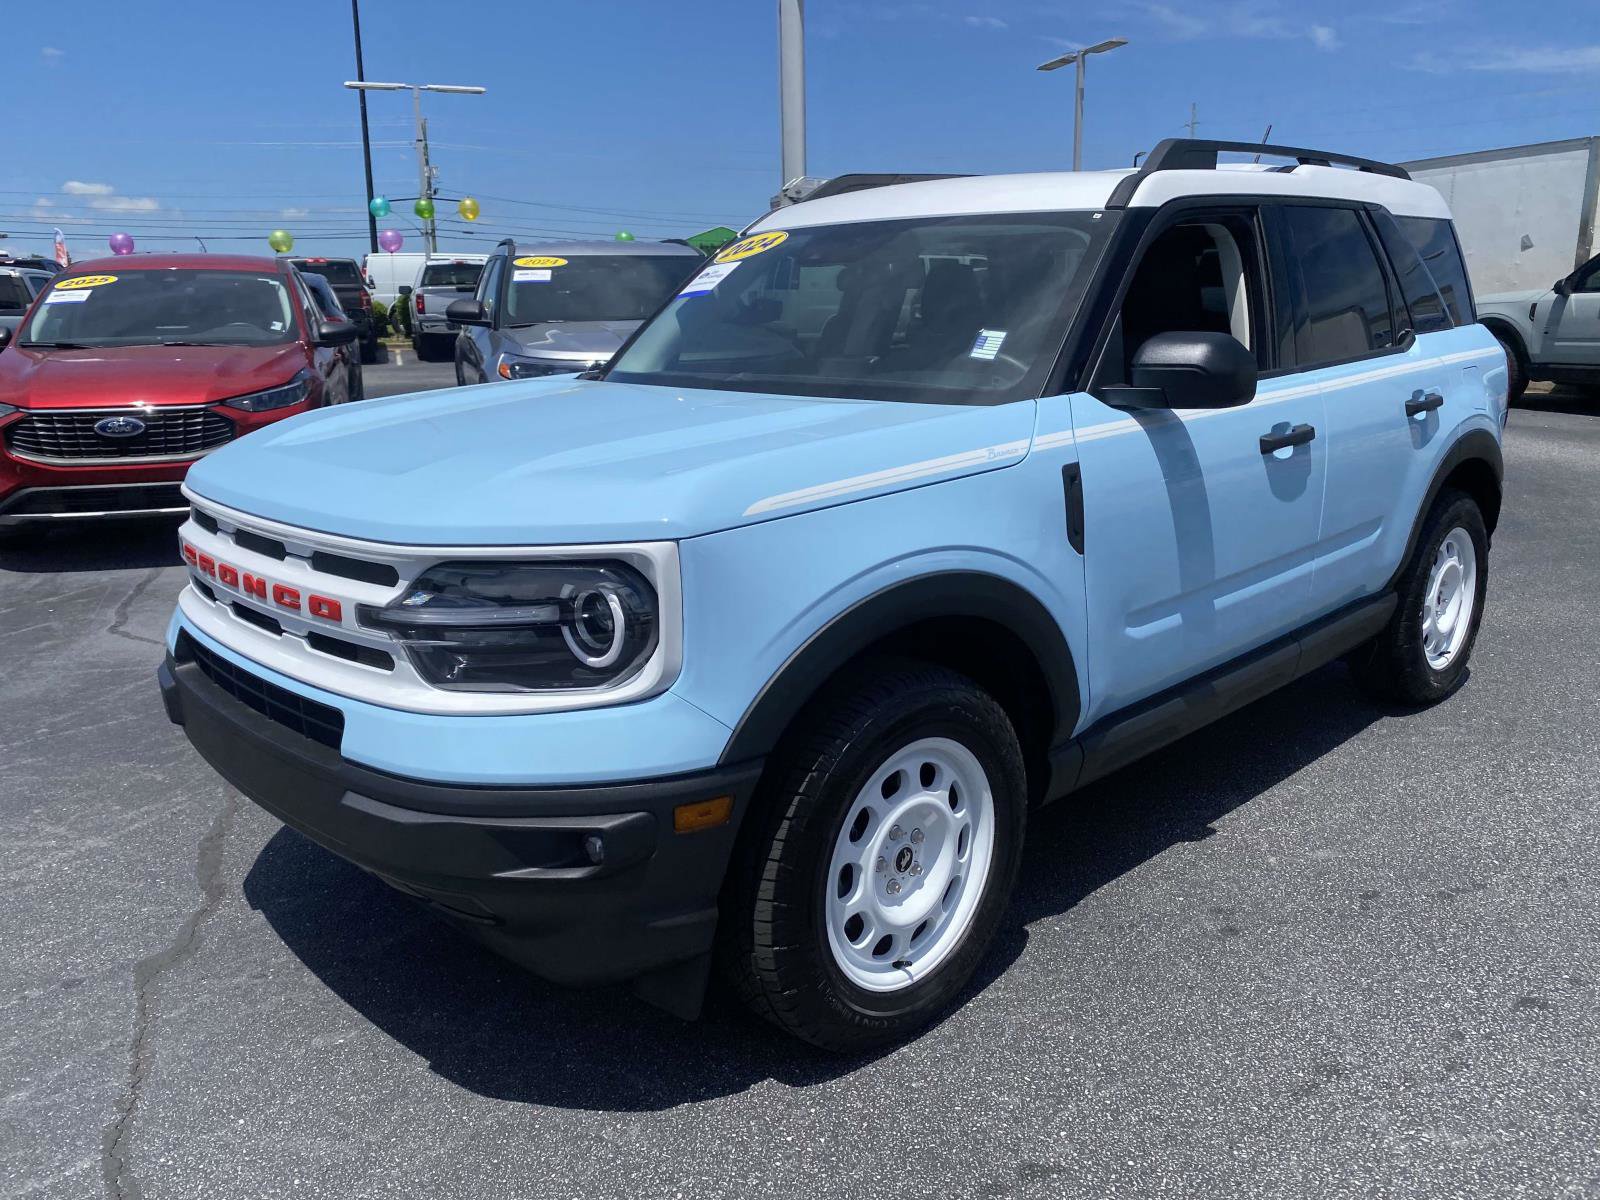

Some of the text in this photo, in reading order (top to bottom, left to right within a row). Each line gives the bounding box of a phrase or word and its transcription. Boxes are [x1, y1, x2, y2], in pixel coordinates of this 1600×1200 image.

[719, 235, 785, 260] 2024
[106, 420, 133, 433] Ford
[183, 543, 343, 623] BRONCO
